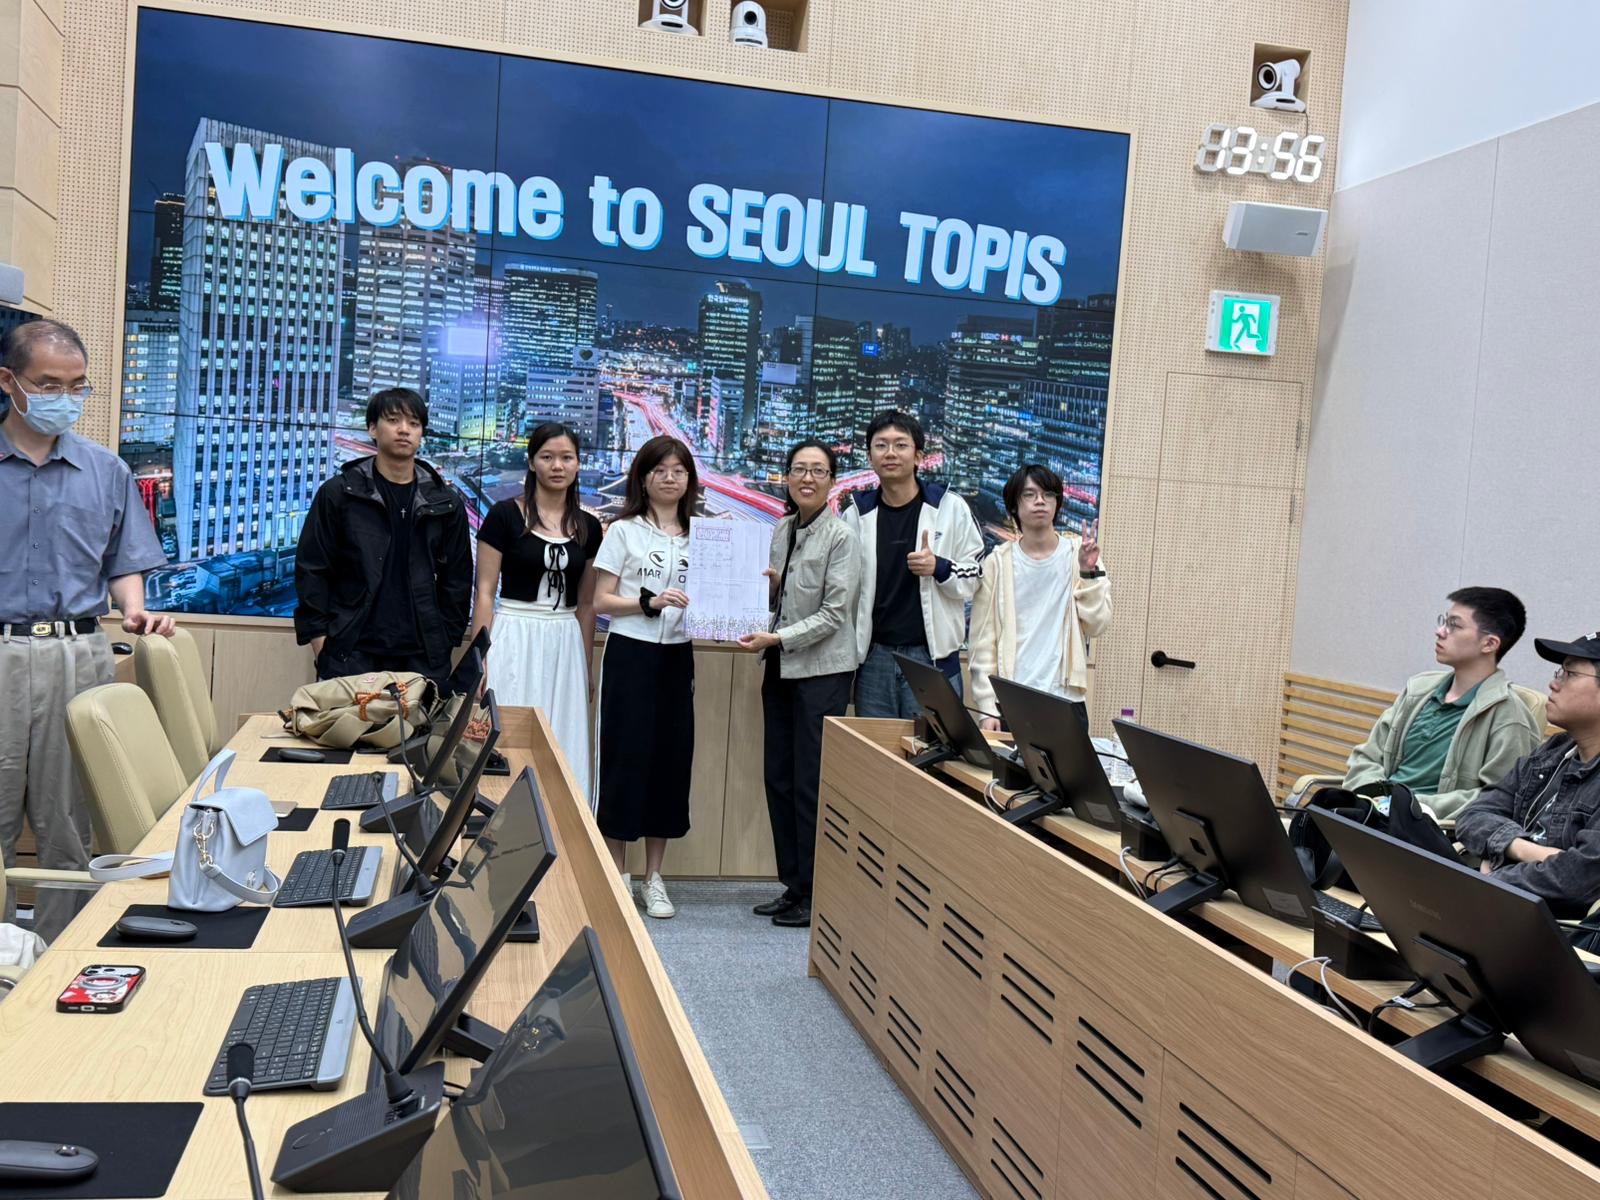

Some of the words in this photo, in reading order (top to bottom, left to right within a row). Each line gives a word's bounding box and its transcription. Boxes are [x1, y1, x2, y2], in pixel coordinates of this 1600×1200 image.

[1216, 126, 1325, 182] 13:56
[205, 142, 564, 240] Welcome
[589, 175, 663, 250] to
[687, 183, 877, 277] SEOUL
[900, 211, 1066, 305] TOPIS
